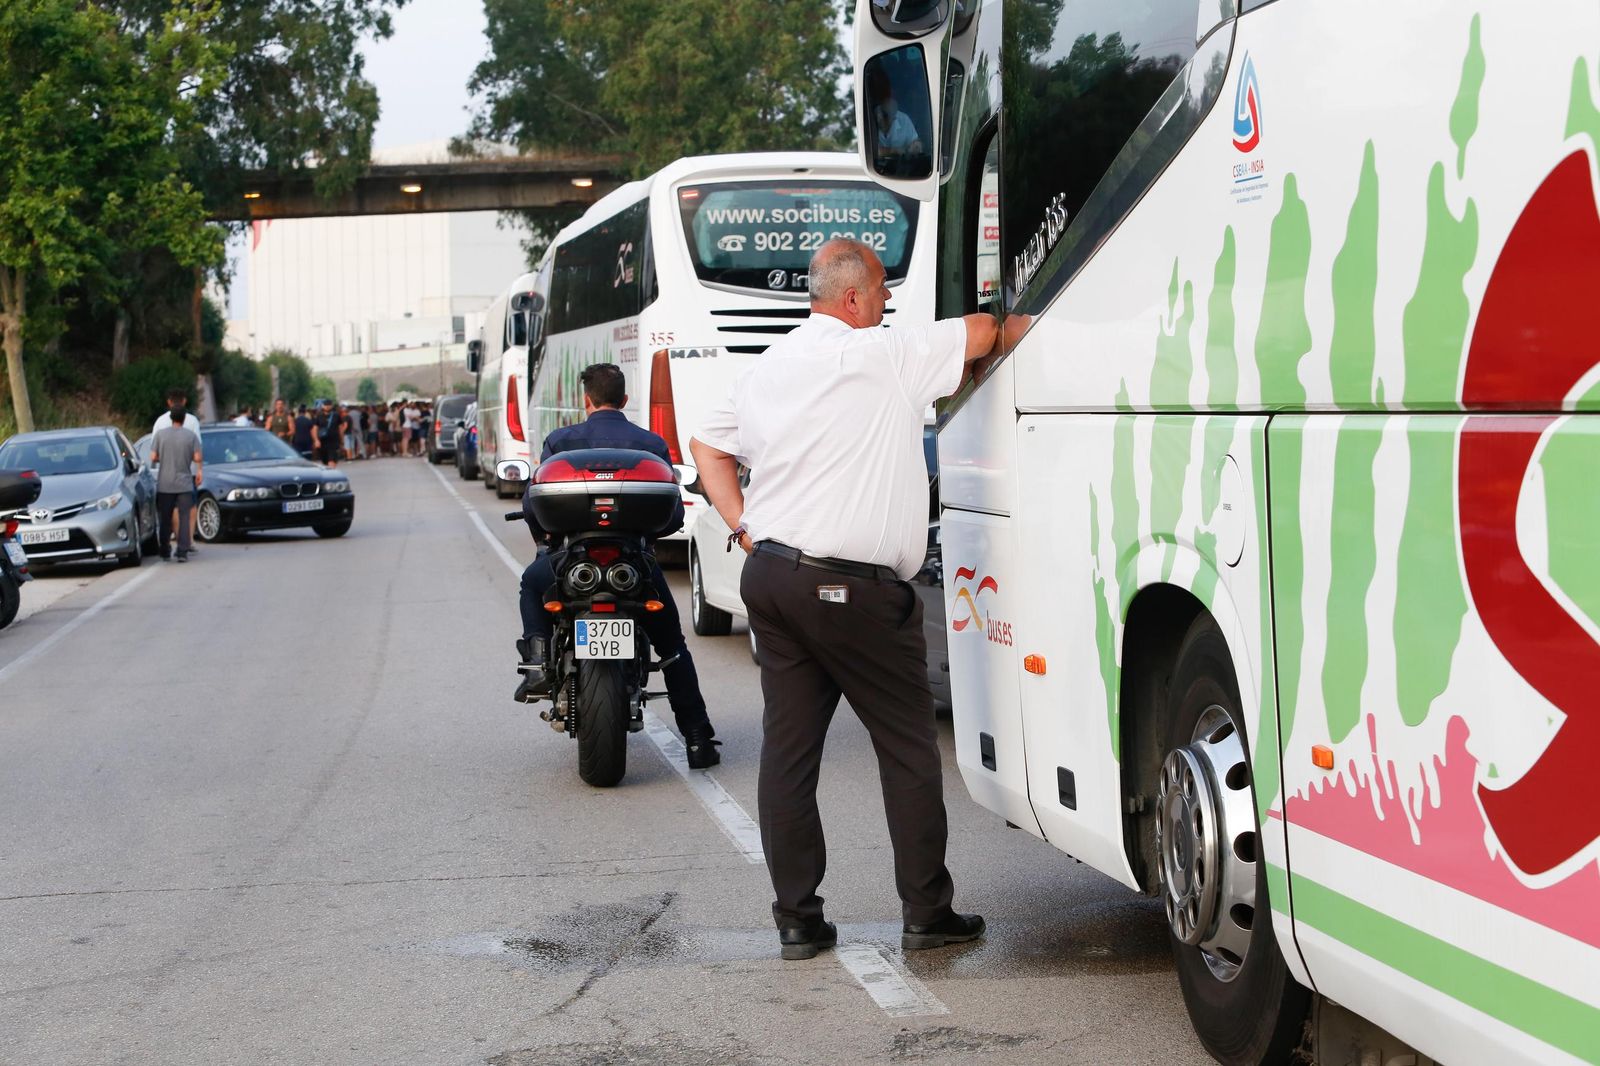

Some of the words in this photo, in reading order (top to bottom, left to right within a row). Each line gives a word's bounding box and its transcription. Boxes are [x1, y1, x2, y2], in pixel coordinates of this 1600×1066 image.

[707, 203, 896, 224] www.socibus.es
[754, 232, 794, 251] 902
[799, 232, 825, 251] 22
[649, 332, 675, 346] 355
[670, 349, 717, 359] MAN
[23, 533, 47, 543] 0985
[49, 530, 66, 540] HSF
[589, 621, 631, 637] 3700
[589, 640, 620, 656] GYB
